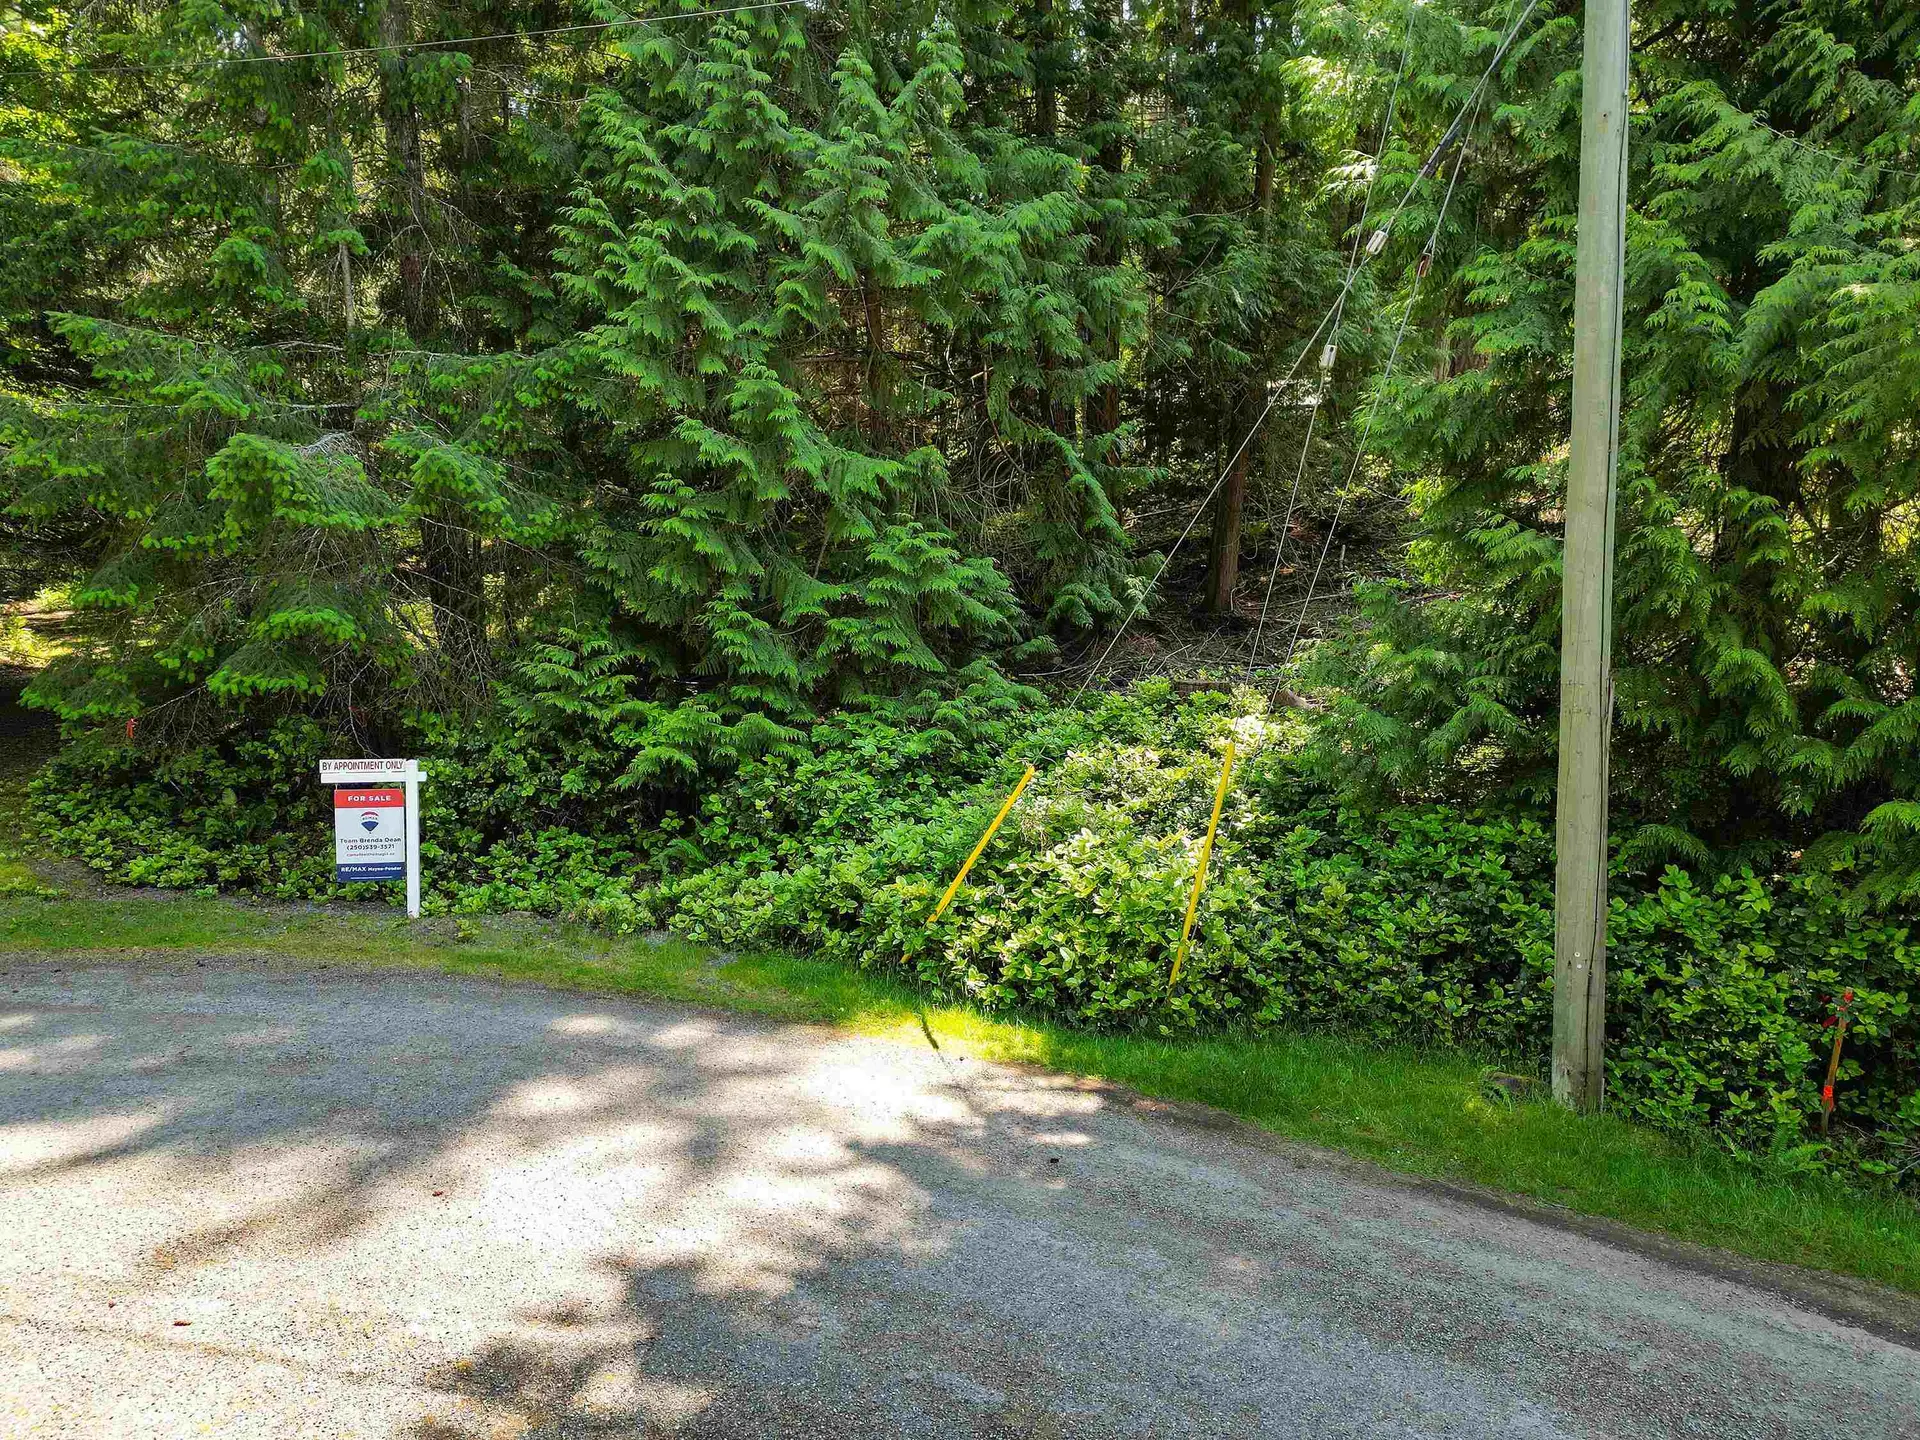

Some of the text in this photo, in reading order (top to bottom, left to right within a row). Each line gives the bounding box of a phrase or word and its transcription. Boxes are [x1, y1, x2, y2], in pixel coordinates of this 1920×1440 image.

[322, 760, 404, 771] BY APPOINTMENT ONLY
